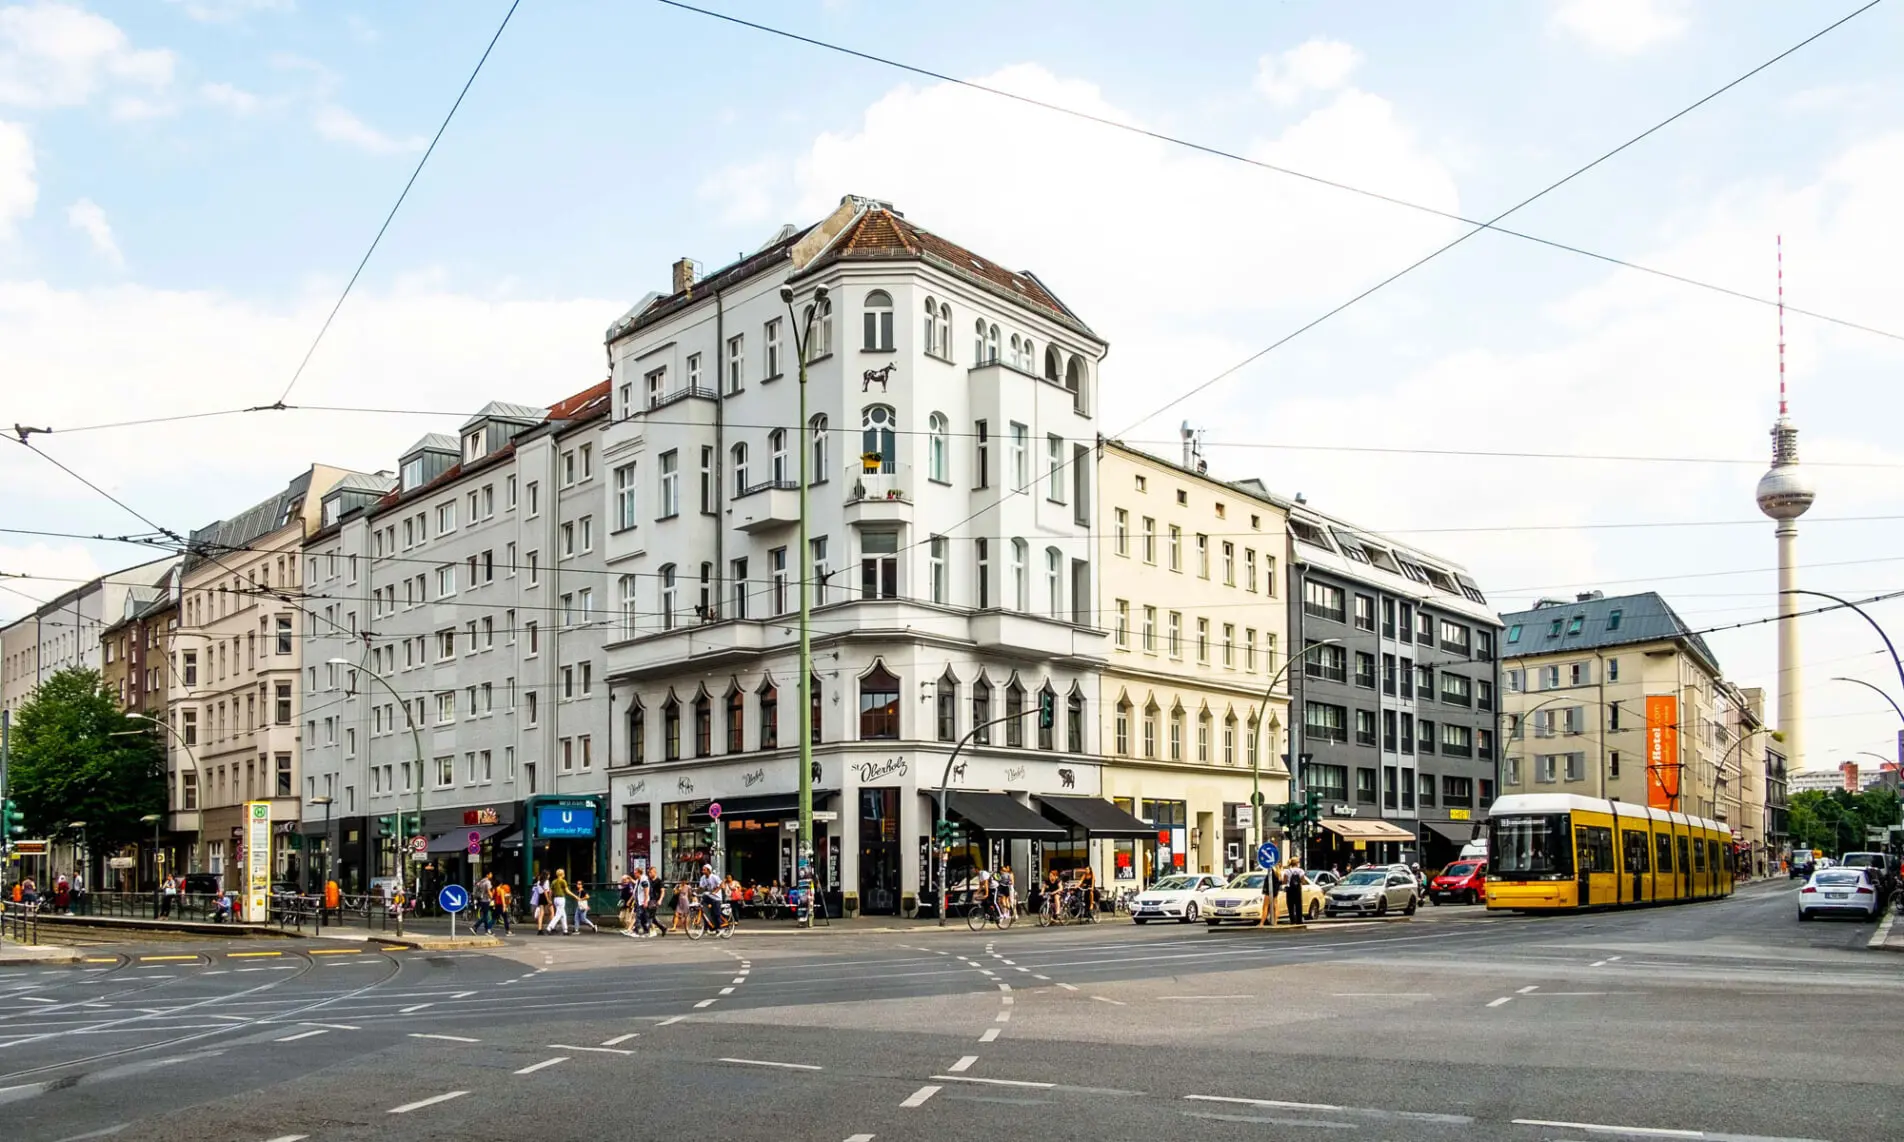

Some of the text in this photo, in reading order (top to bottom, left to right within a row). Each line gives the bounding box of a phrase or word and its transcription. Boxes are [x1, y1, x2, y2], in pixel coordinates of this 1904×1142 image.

[860, 756, 908, 783] Oberholz
[562, 811, 572, 823] U
[415, 840, 424, 848] 30
